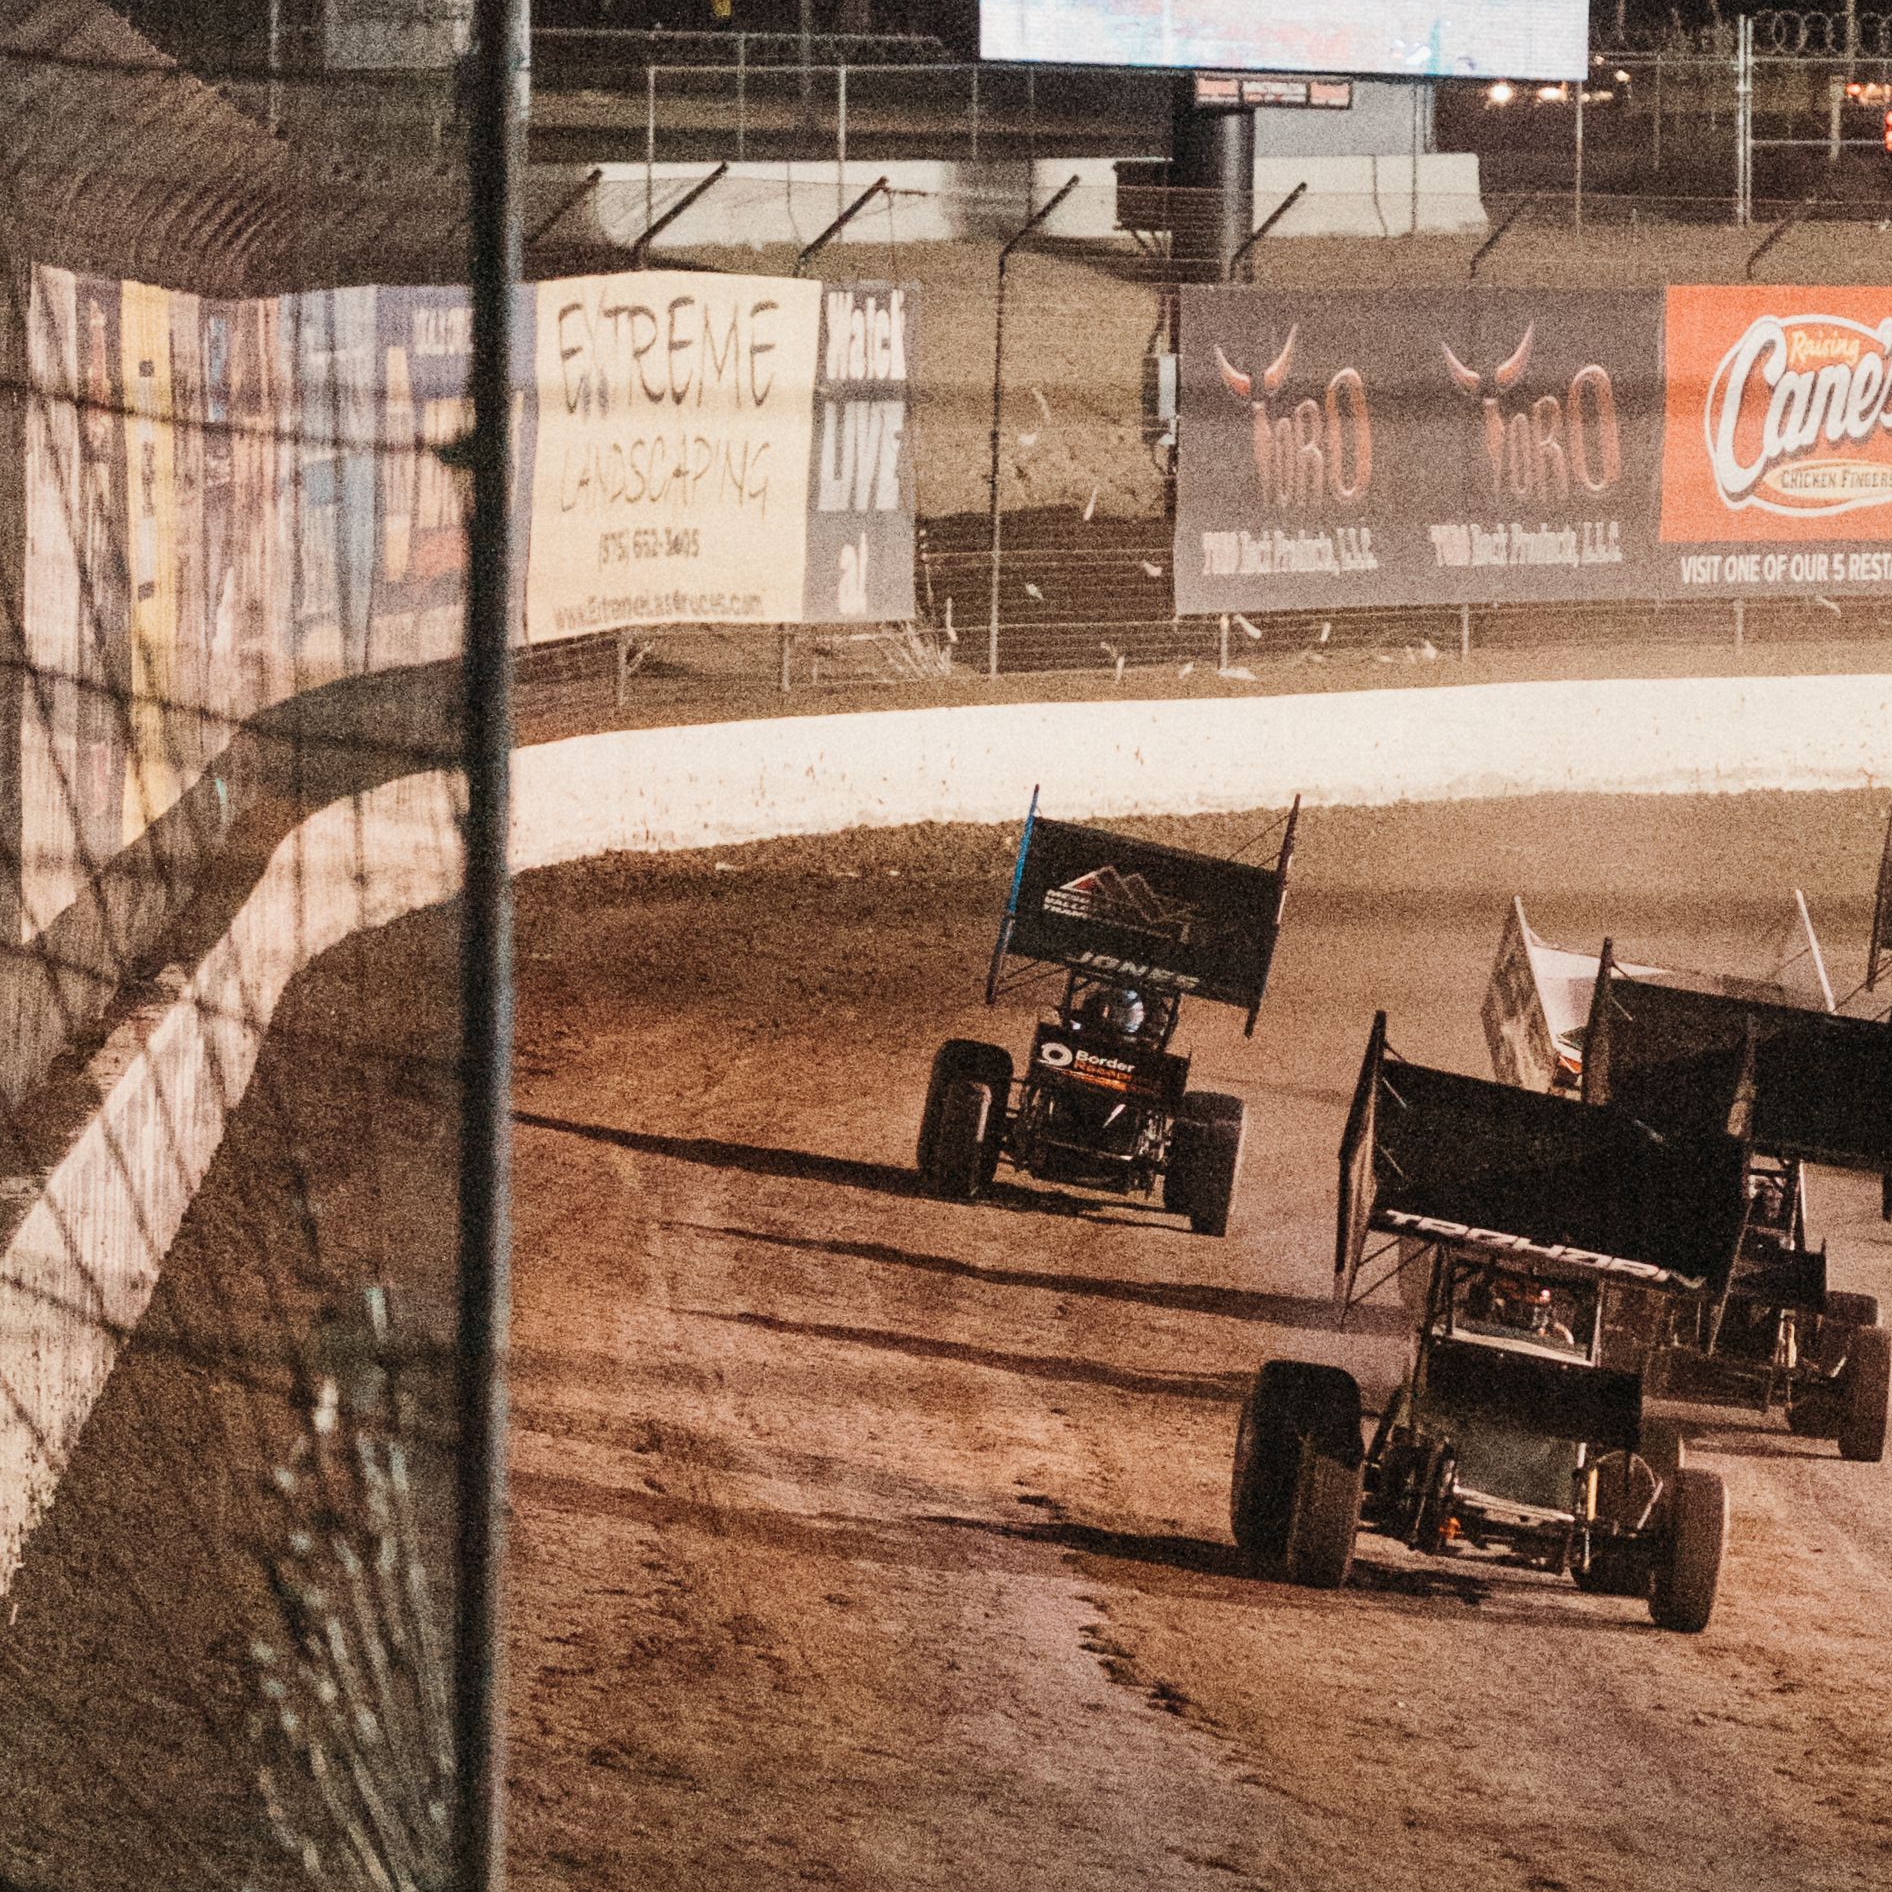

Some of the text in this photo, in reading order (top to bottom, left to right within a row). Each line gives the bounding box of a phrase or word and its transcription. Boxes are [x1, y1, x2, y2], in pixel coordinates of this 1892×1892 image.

[558, 291, 779, 417] EXTREME
[1789, 330, 1860, 366] Raising
[560, 436, 770, 516] LANDSCAPING
[1781, 469, 1836, 489] CHICKEN
[1681, 555, 1722, 584] VISIT
[1725, 555, 1760, 583] ONE
[1763, 554, 1788, 582] OF
[1791, 553, 1828, 582] OUR
[1832, 553, 1845, 581] 5
[1066, 951, 1201, 989] JONES
[1076, 1049, 1136, 1074] Border
